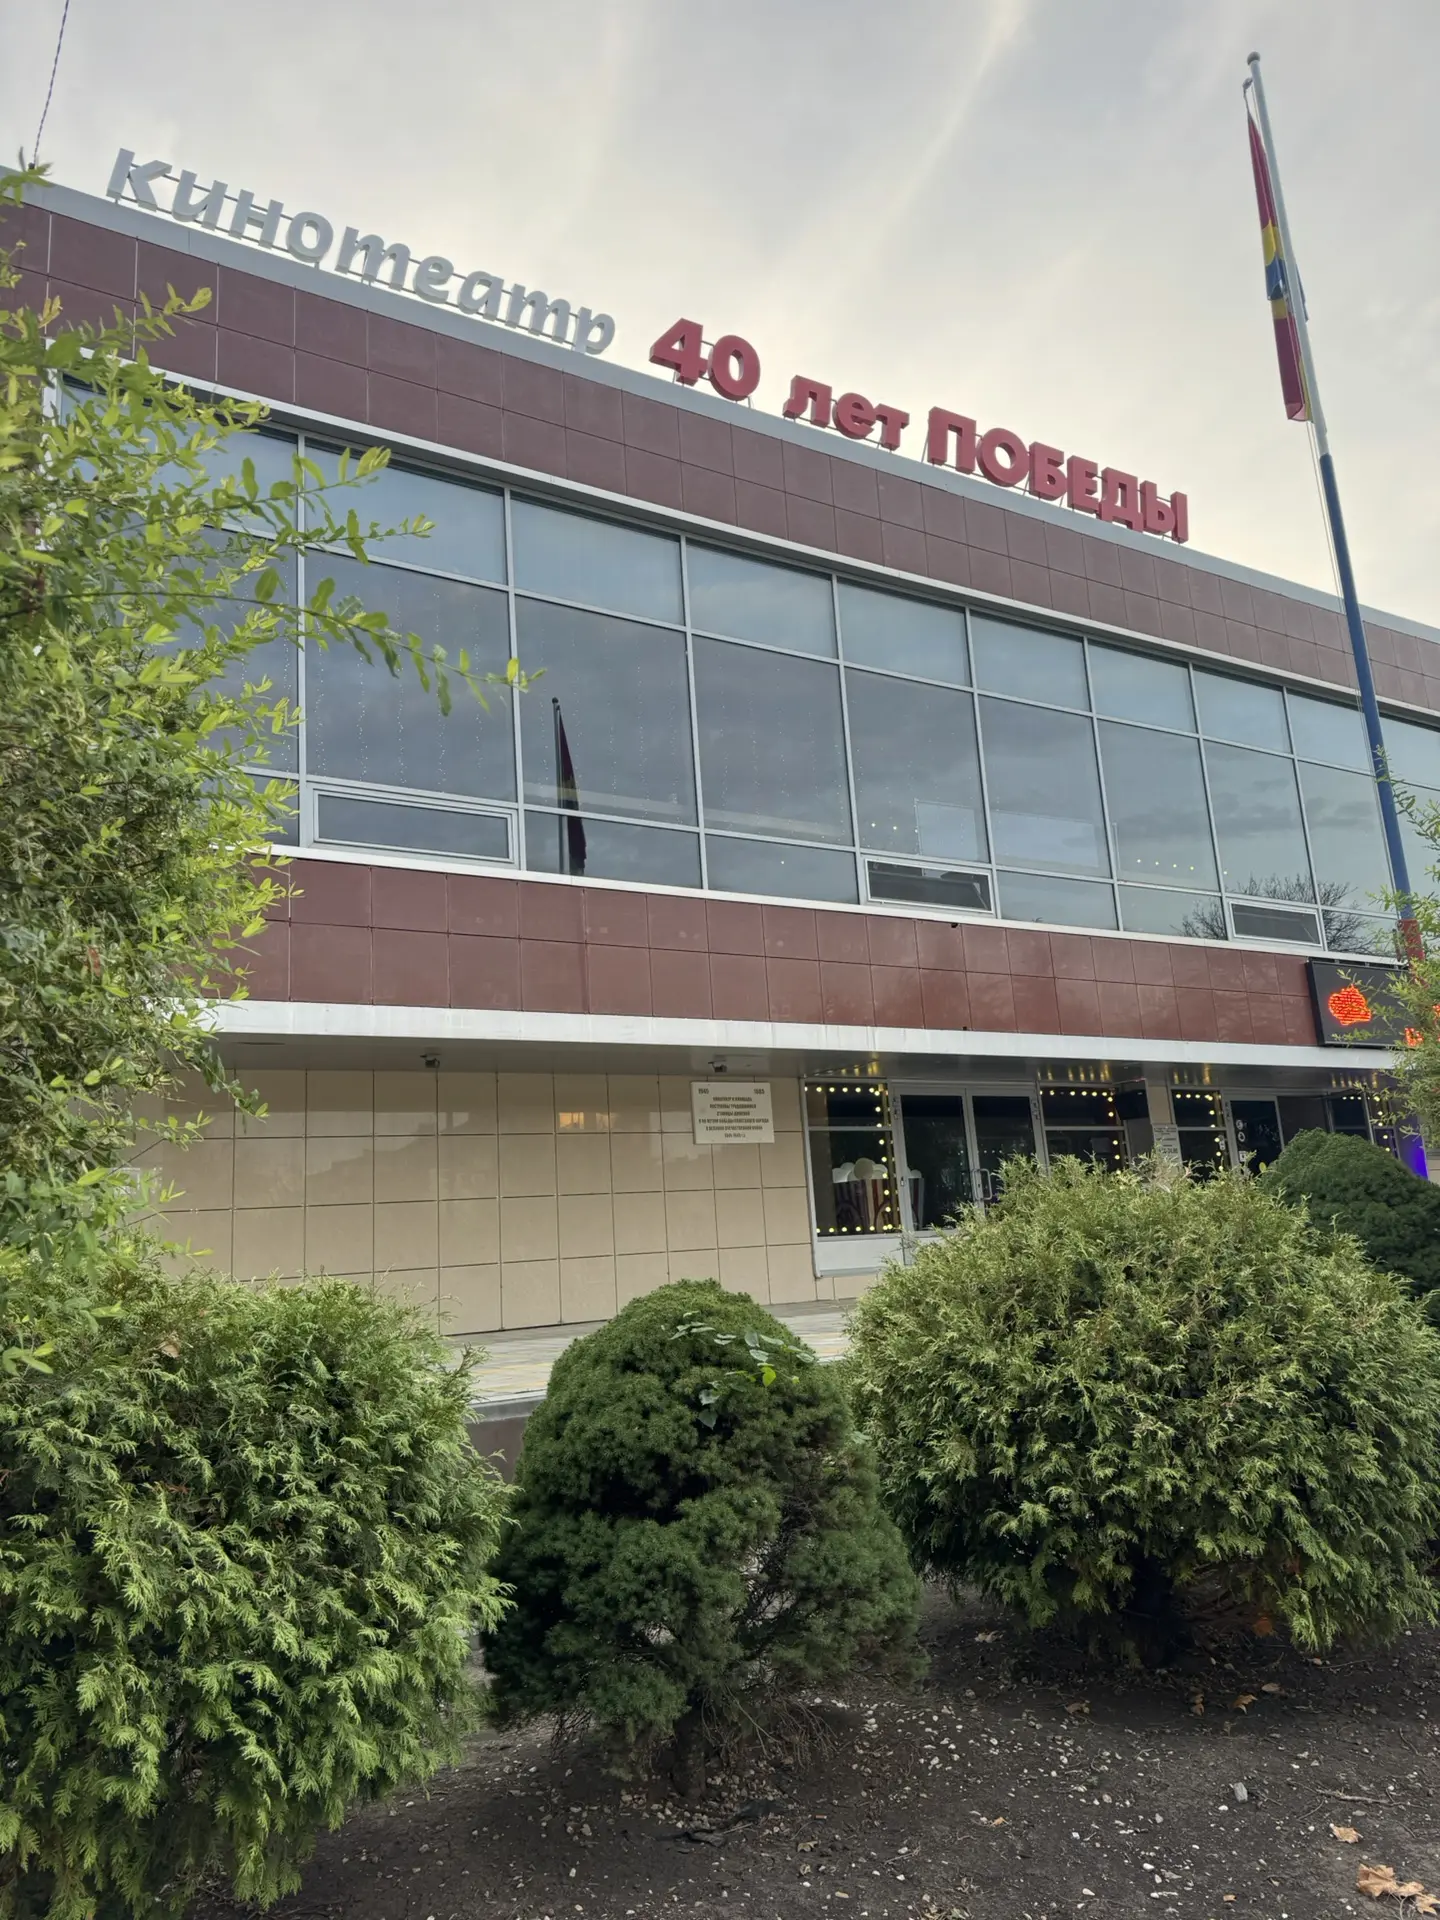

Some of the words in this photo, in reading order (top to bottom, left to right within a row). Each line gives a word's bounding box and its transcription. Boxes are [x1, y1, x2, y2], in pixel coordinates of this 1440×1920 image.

[649, 318, 760, 401] 40
[783, 375, 909, 450] лет
[927, 407, 1188, 544] ПОБЕДЫ
